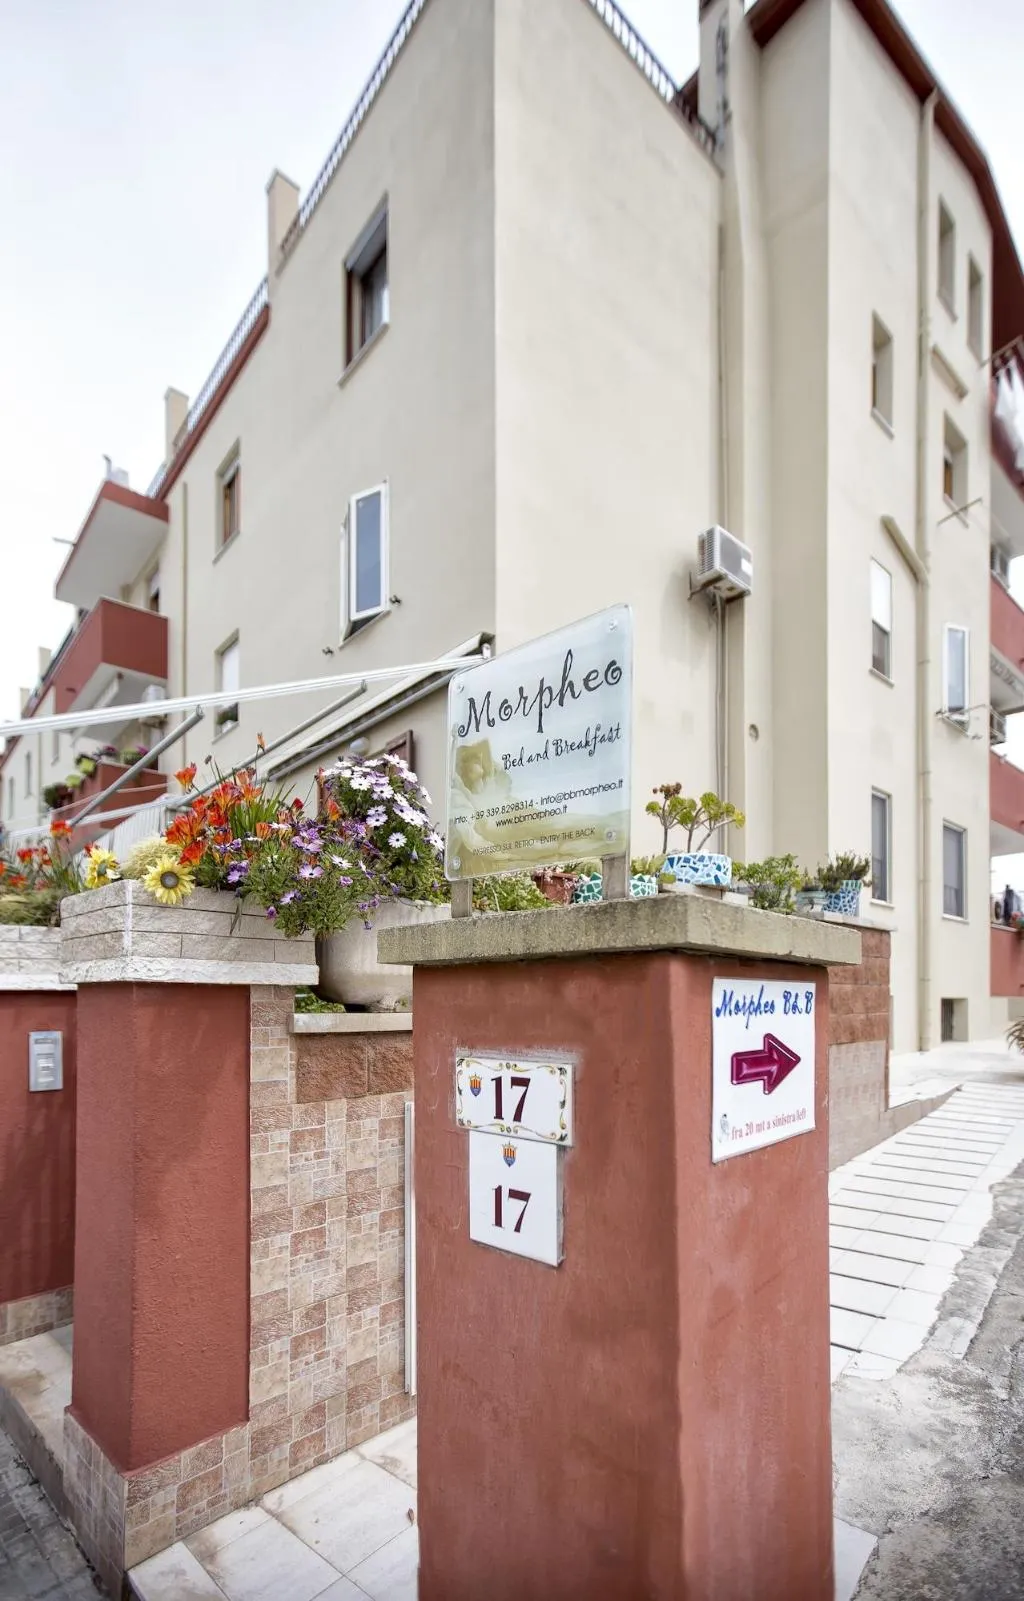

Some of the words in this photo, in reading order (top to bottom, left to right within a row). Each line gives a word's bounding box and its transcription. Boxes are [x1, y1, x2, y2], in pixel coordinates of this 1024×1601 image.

[458, 649, 622, 737] Morpheo
[502, 747, 525, 770] Bed
[526, 739, 550, 763] and
[552, 722, 621, 757] Breakfast
[471, 810, 485, 821] +39
[486, 799, 534, 818] 339.8298314
[495, 804, 568, 828] www.bbmorpheo.it
[514, 838, 535, 849] RETRO
[540, 833, 560, 845] ENTRY
[562, 831, 574, 840] THE
[575, 827, 596, 838] BACK
[491, 1076, 531, 1123] 17
[731, 1125, 744, 1141] fra
[745, 1121, 754, 1137] 20
[755, 1119, 766, 1133] mt
[767, 1119, 772, 1130] a
[491, 1184, 532, 1234] 17
